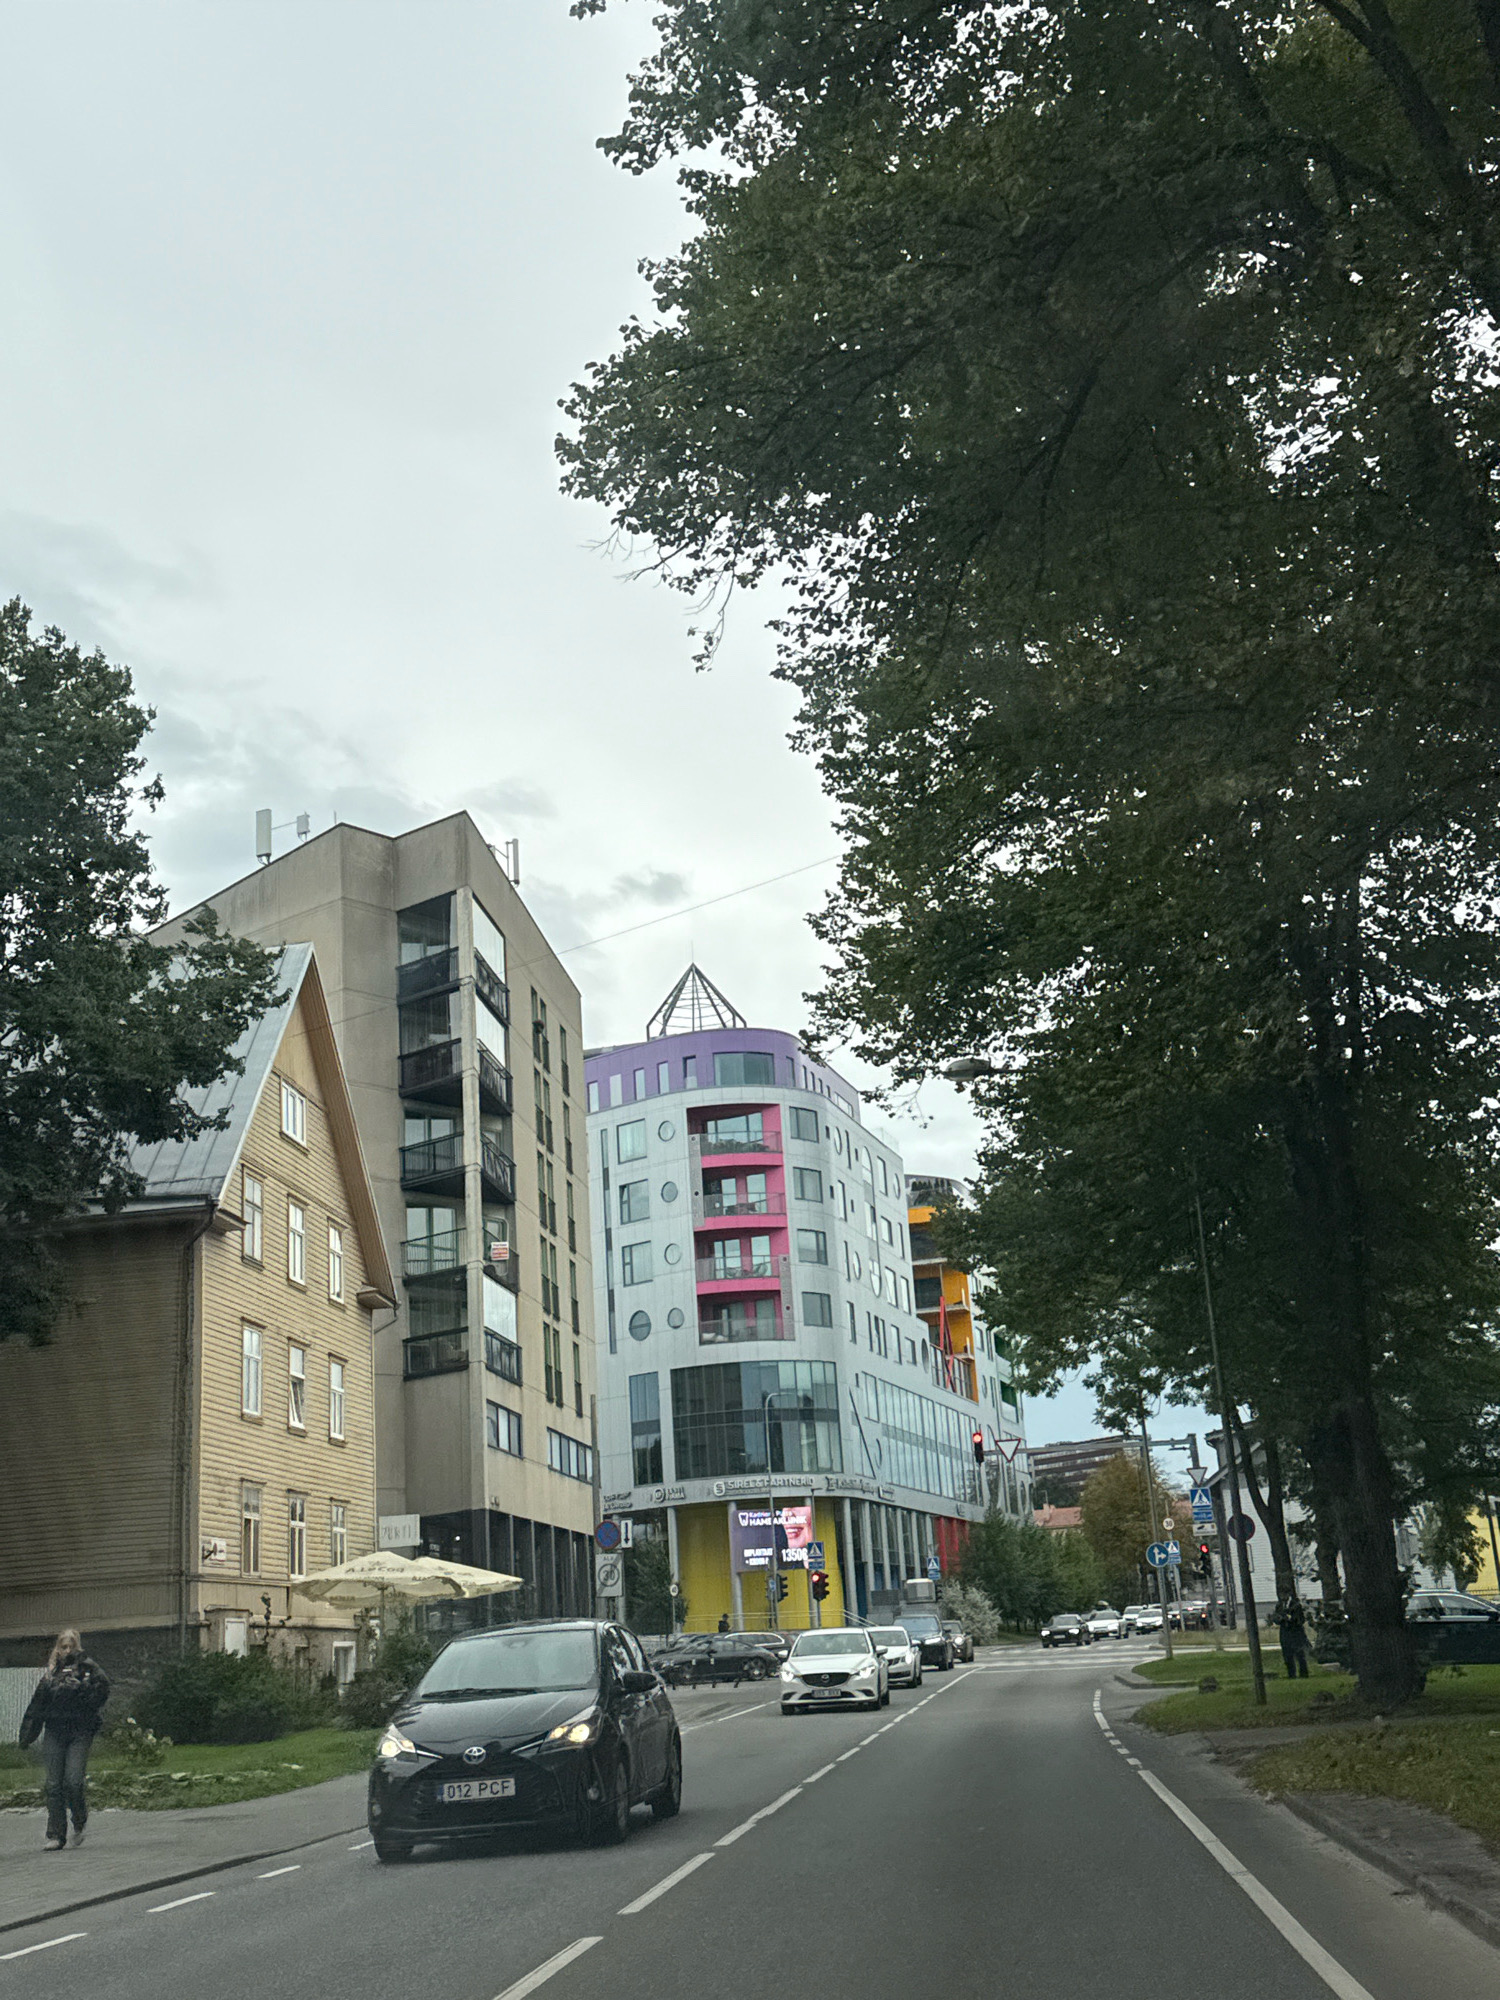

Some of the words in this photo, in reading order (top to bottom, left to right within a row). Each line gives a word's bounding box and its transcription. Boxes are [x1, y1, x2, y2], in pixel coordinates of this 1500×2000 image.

[1165, 1520, 1173, 1528] 30
[447, 1784, 472, 1799] 012
[478, 1780, 510, 1796] PCF
